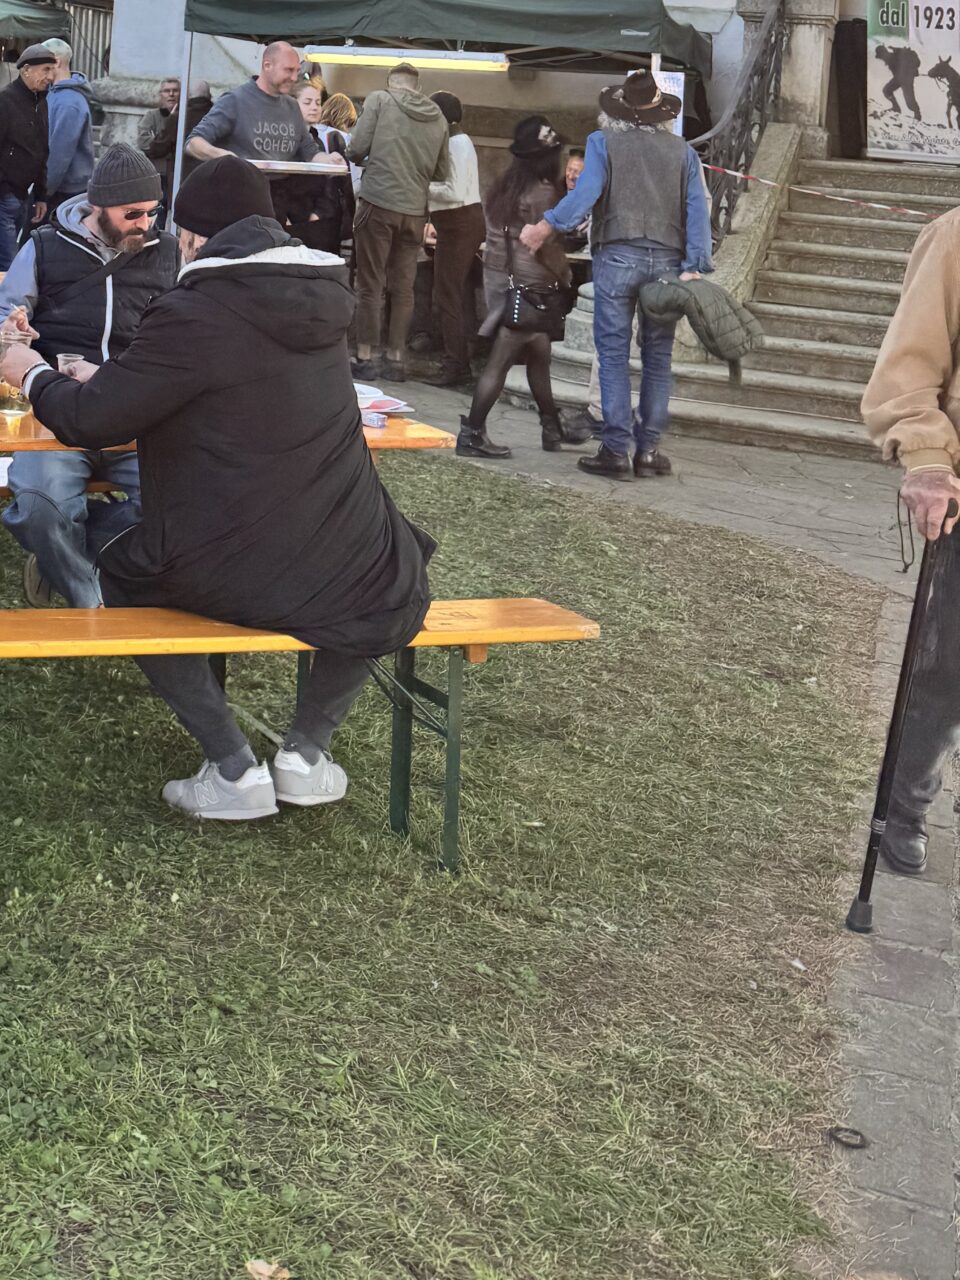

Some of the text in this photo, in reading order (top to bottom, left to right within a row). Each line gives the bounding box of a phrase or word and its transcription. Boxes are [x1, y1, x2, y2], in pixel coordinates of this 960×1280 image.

[880, 1, 955, 30] dal 1923
[253, 121, 295, 137] JACOB
